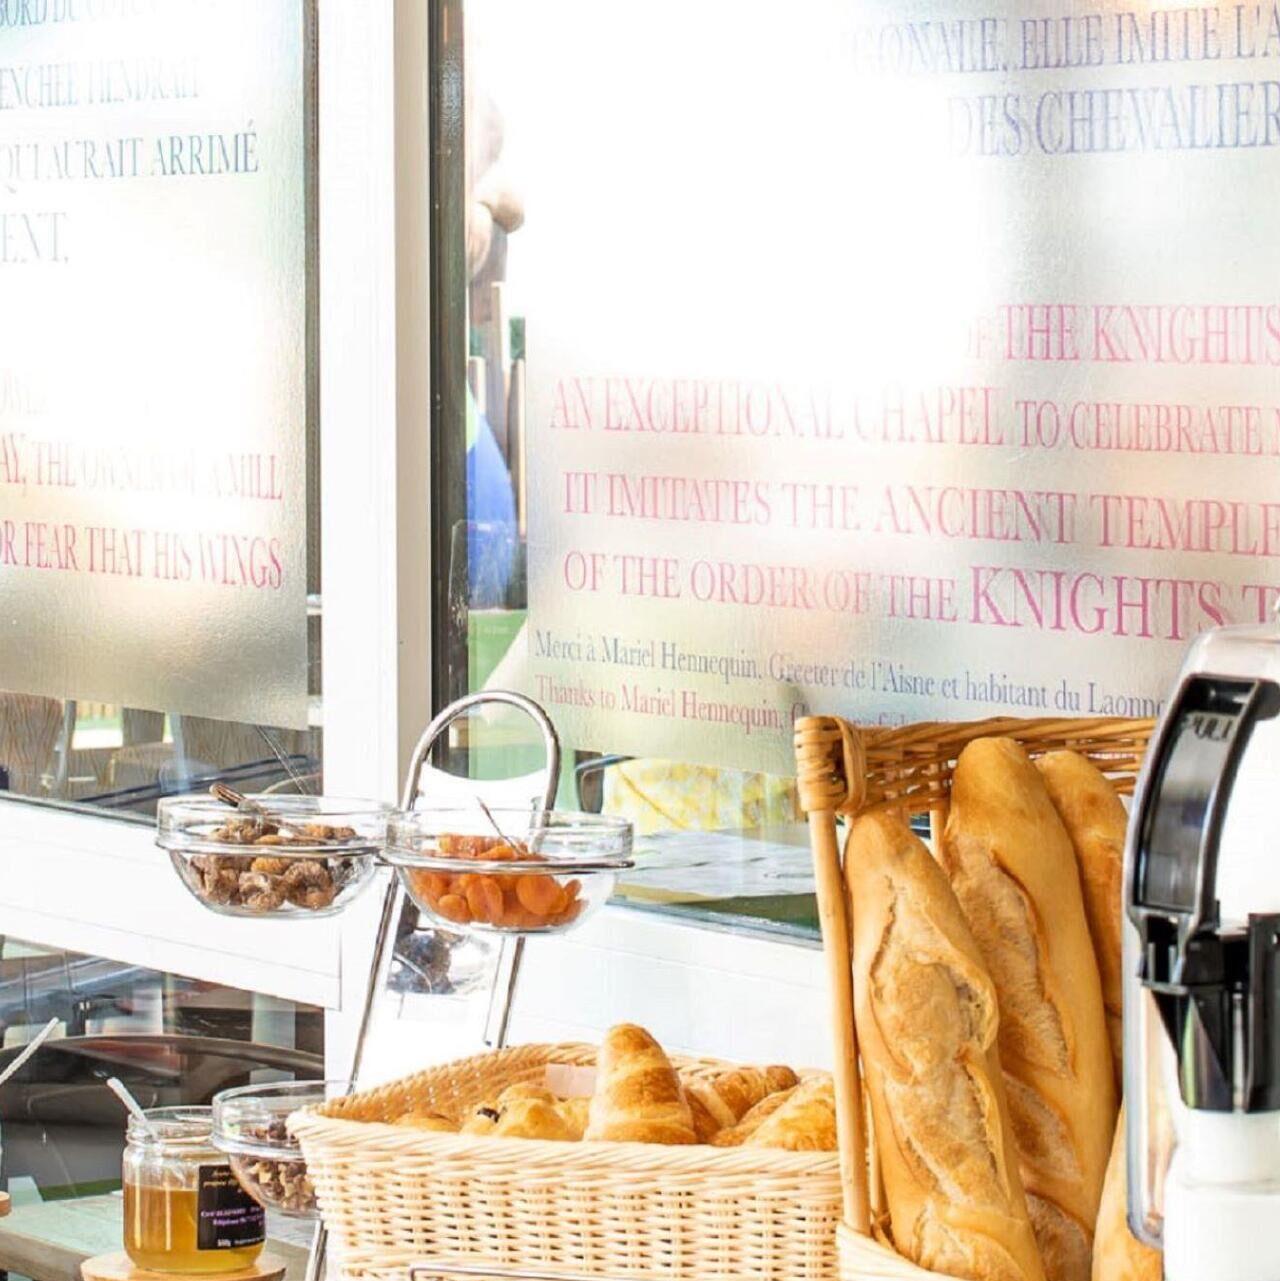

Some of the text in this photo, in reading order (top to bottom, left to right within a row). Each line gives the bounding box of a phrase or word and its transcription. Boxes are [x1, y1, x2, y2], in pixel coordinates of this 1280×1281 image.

[1019, 14, 1104, 70] ELLE
[1116, 7, 1222, 66] IMITE
[152, 119, 259, 177] ARRIMÉ
[999, 303, 1080, 362] THE
[550, 376, 596, 430] AN
[603, 376, 845, 440] EXCEPTIONAL
[853, 383, 1004, 447] CHAPEL
[1016, 400, 1060, 449] TO
[1069, 402, 1263, 456] CELEBRATE
[562, 471, 598, 515] IT
[606, 473, 772, 525] IMITATES
[782, 481, 862, 532] THE
[873, 483, 1077, 544] ANCIENT
[24, 521, 81, 573] FEAR
[85, 526, 146, 578] THAT
[152, 528, 193, 582] HIS
[198, 530, 285, 591] WINGS
[564, 551, 607, 592] OF
[613, 554, 682, 600] THE
[689, 559, 817, 610] ORDER
[823, 567, 874, 616] OF
[880, 573, 958, 623] THE
[969, 564, 1228, 641] KNIGHTS
[534, 673, 594, 706] Thanks
[600, 686, 616, 712] to
[622, 683, 676, 721] Mariel
[536, 628, 584, 659] Merci
[586, 636, 596, 660] à
[602, 635, 655, 669] Mariel
[844, 661, 866, 690] de
[872, 662, 935, 699] l'Aisne
[941, 676, 959, 699] et
[965, 671, 1049, 708] habitant
[1054, 679, 1081, 713] du
